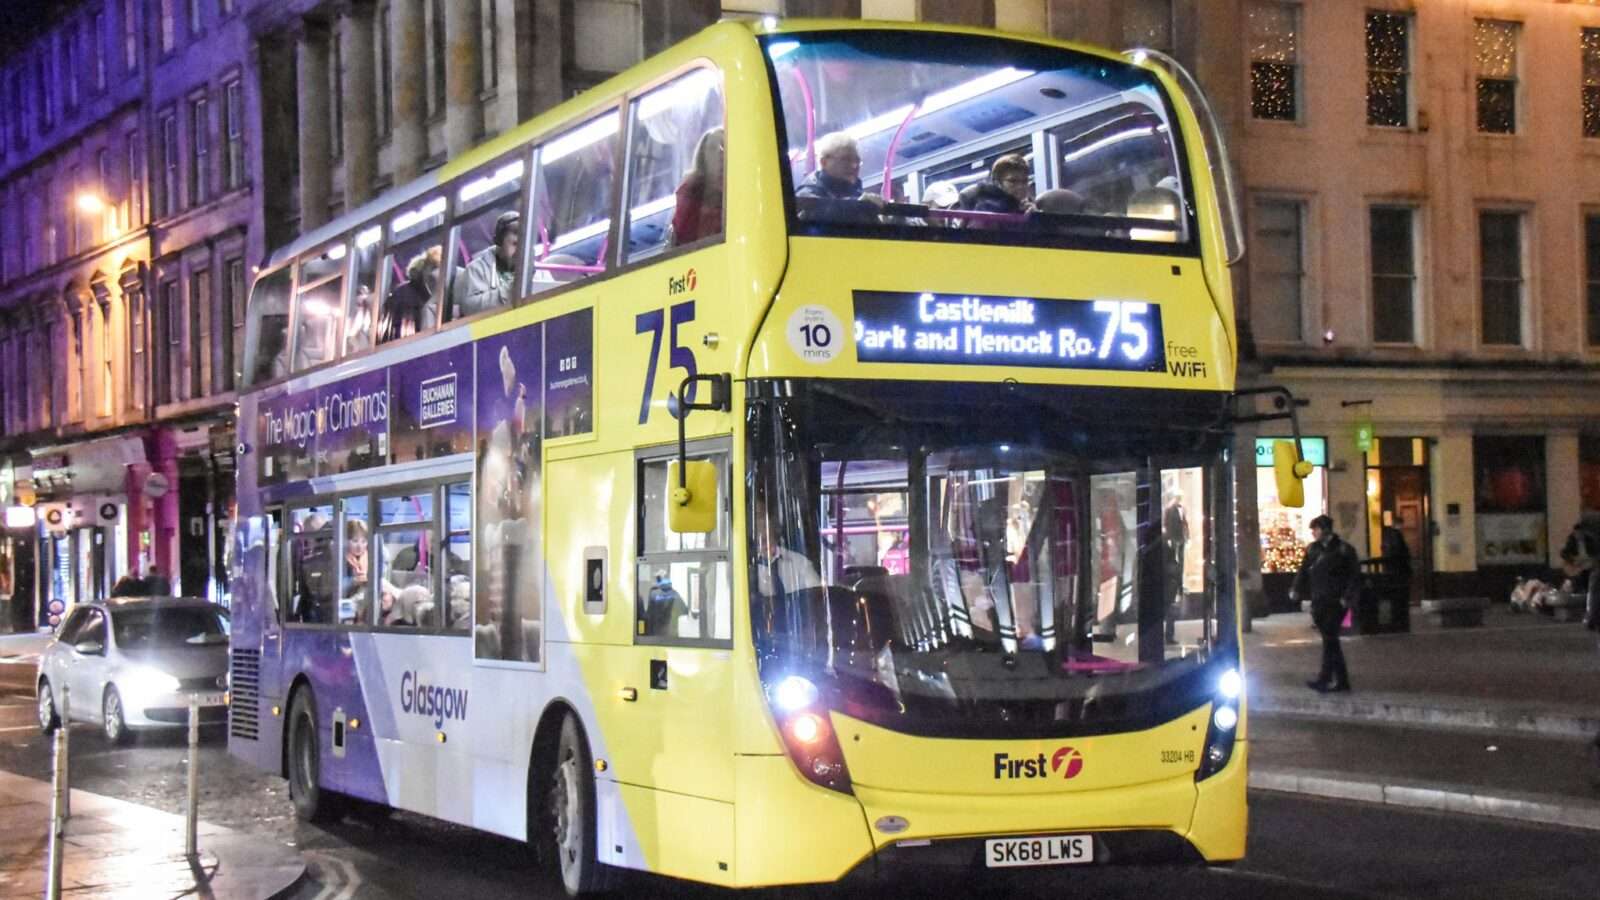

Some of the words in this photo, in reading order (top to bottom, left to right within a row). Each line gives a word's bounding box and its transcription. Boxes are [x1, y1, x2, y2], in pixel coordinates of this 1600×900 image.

[669, 276, 686, 296] First
[918, 293, 1035, 324] Castlemilk
[799, 324, 831, 347] 10
[915, 328, 957, 351] and
[964, 327, 1053, 355] Menock
[1093, 299, 1149, 361] 75
[803, 350, 832, 359] mins
[1167, 340, 1198, 357] free
[636, 300, 698, 424] 75
[1170, 362, 1207, 379] WiFi
[422, 382, 455, 404] BUCHANAN
[265, 408, 283, 445] The
[284, 407, 316, 448] Magic
[317, 395, 329, 435] of
[330, 388, 387, 432] Christmas
[422, 399, 455, 420] GALLERIES
[401, 670, 468, 729] Glasgow
[994, 753, 1047, 779] First
[1161, 750, 1182, 763] 33204
[993, 840, 1042, 862] SK68
[1048, 838, 1083, 859] LWS
